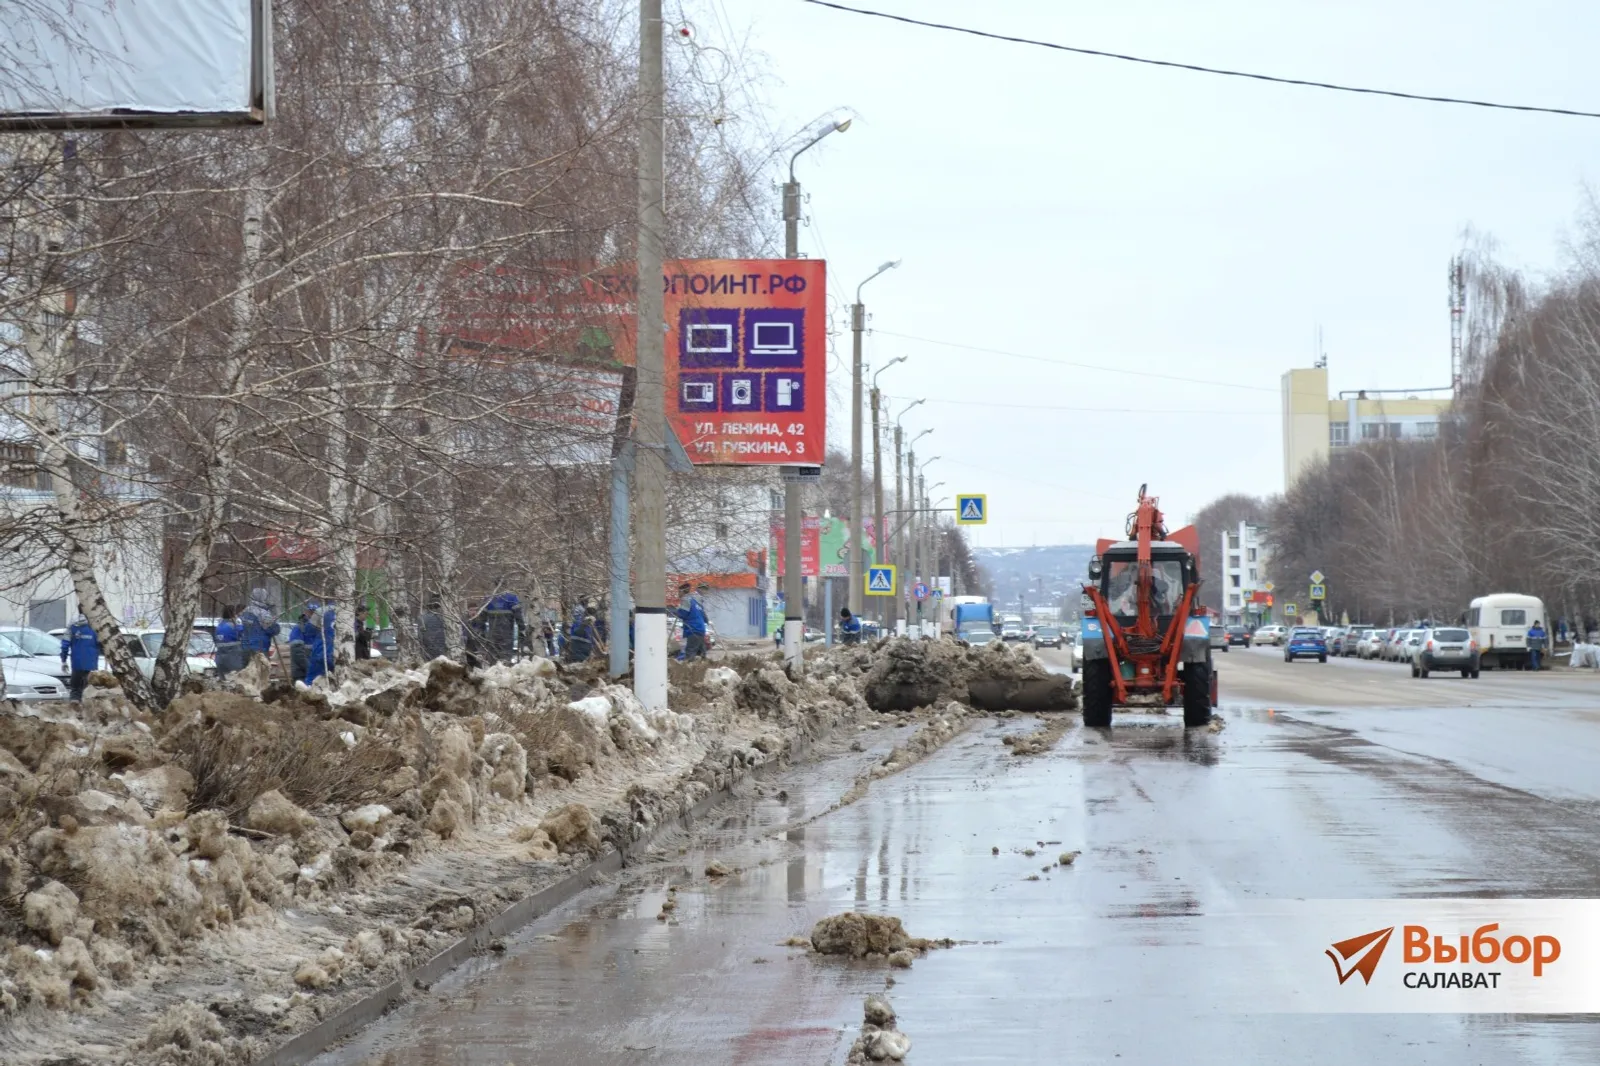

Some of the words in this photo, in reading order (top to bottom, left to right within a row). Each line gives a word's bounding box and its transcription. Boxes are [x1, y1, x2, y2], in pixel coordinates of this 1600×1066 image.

[694, 422, 717, 435] УЛ.
[722, 422, 784, 437] ЛЕНИНА,
[787, 423, 805, 436] 42
[694, 441, 717, 455] УЛ.
[722, 442, 792, 456] ГУБКИНА,
[796, 442, 805, 454] 3
